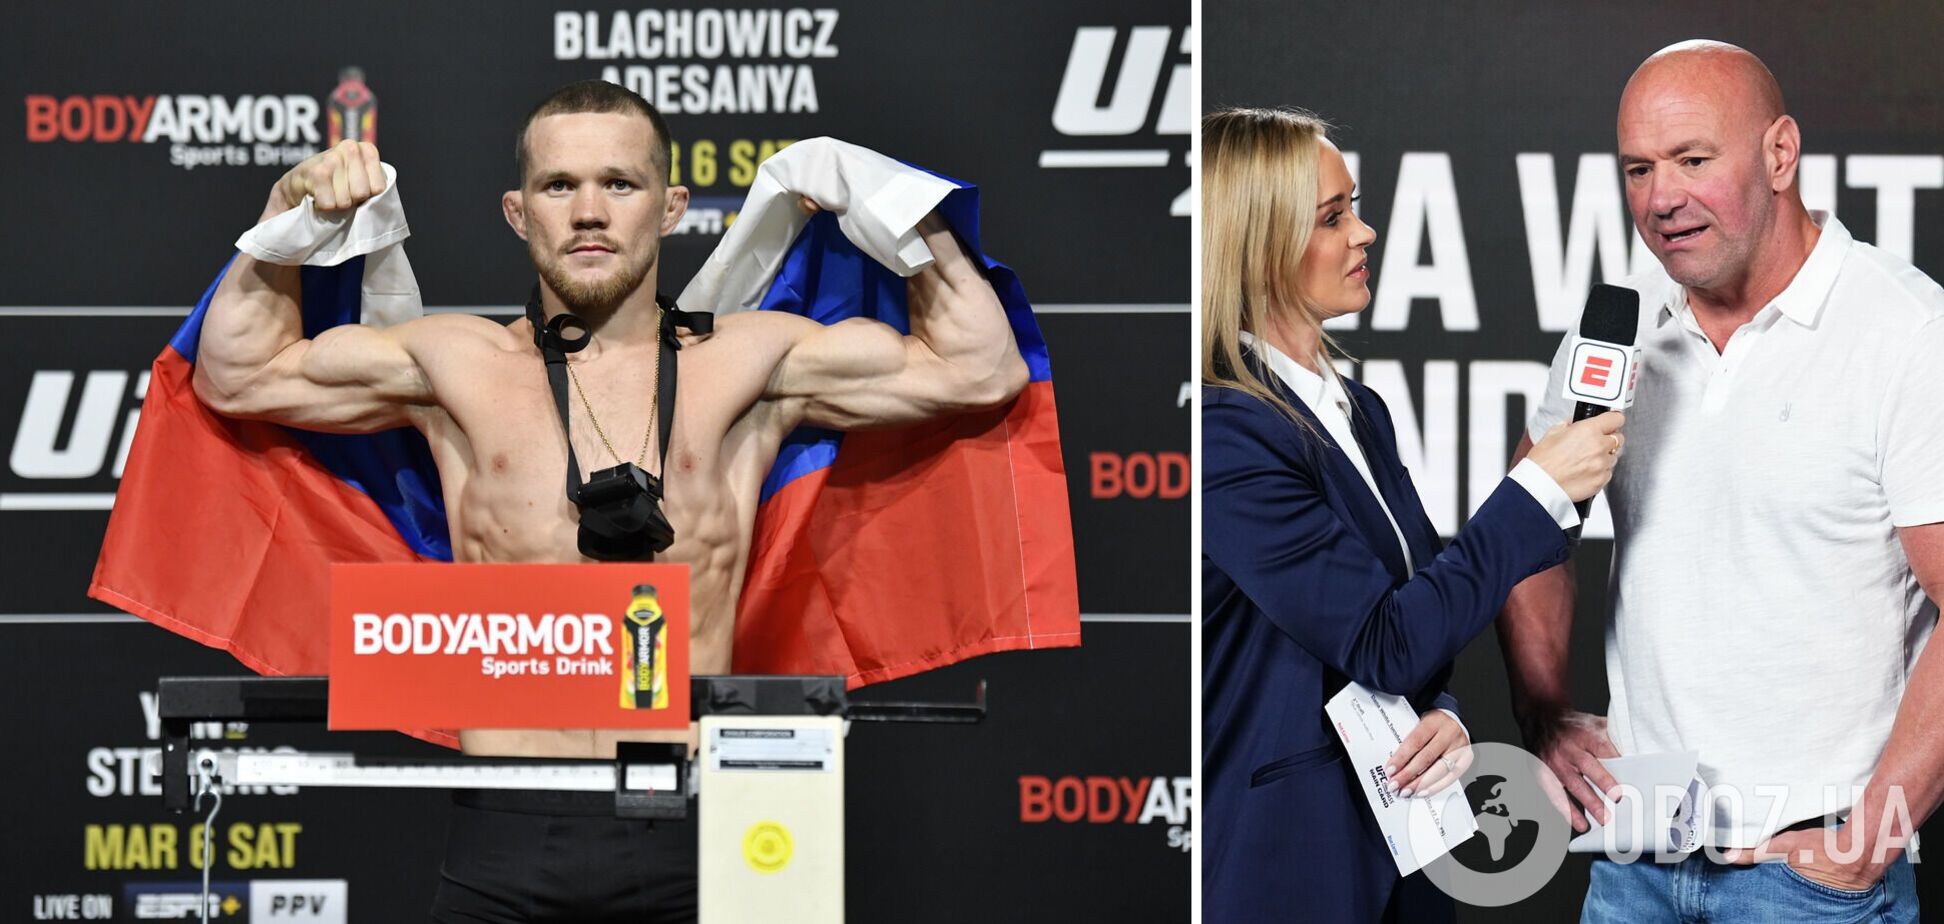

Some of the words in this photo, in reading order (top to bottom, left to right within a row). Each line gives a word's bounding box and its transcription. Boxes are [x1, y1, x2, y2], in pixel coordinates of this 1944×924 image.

[553, 10, 840, 60] BLACHOWICZ
[25, 95, 321, 144] BODYARMOR
[169, 143, 249, 170] Sports
[691, 139, 717, 187] 6
[352, 613, 615, 655] BODYARMOR
[481, 656, 549, 678] Sports
[556, 656, 614, 676] Drink
[1369, 768, 1380, 788] MAIN
[1377, 787, 1390, 809] CARD
[1375, 764, 1389, 783] UFC
[84, 824, 178, 870] MAR
[189, 823, 216, 869] 6
[227, 822, 303, 870] SAT
[33, 894, 80, 920] LIVE
[82, 894, 113, 920] ON
[270, 895, 327, 917] PPV
